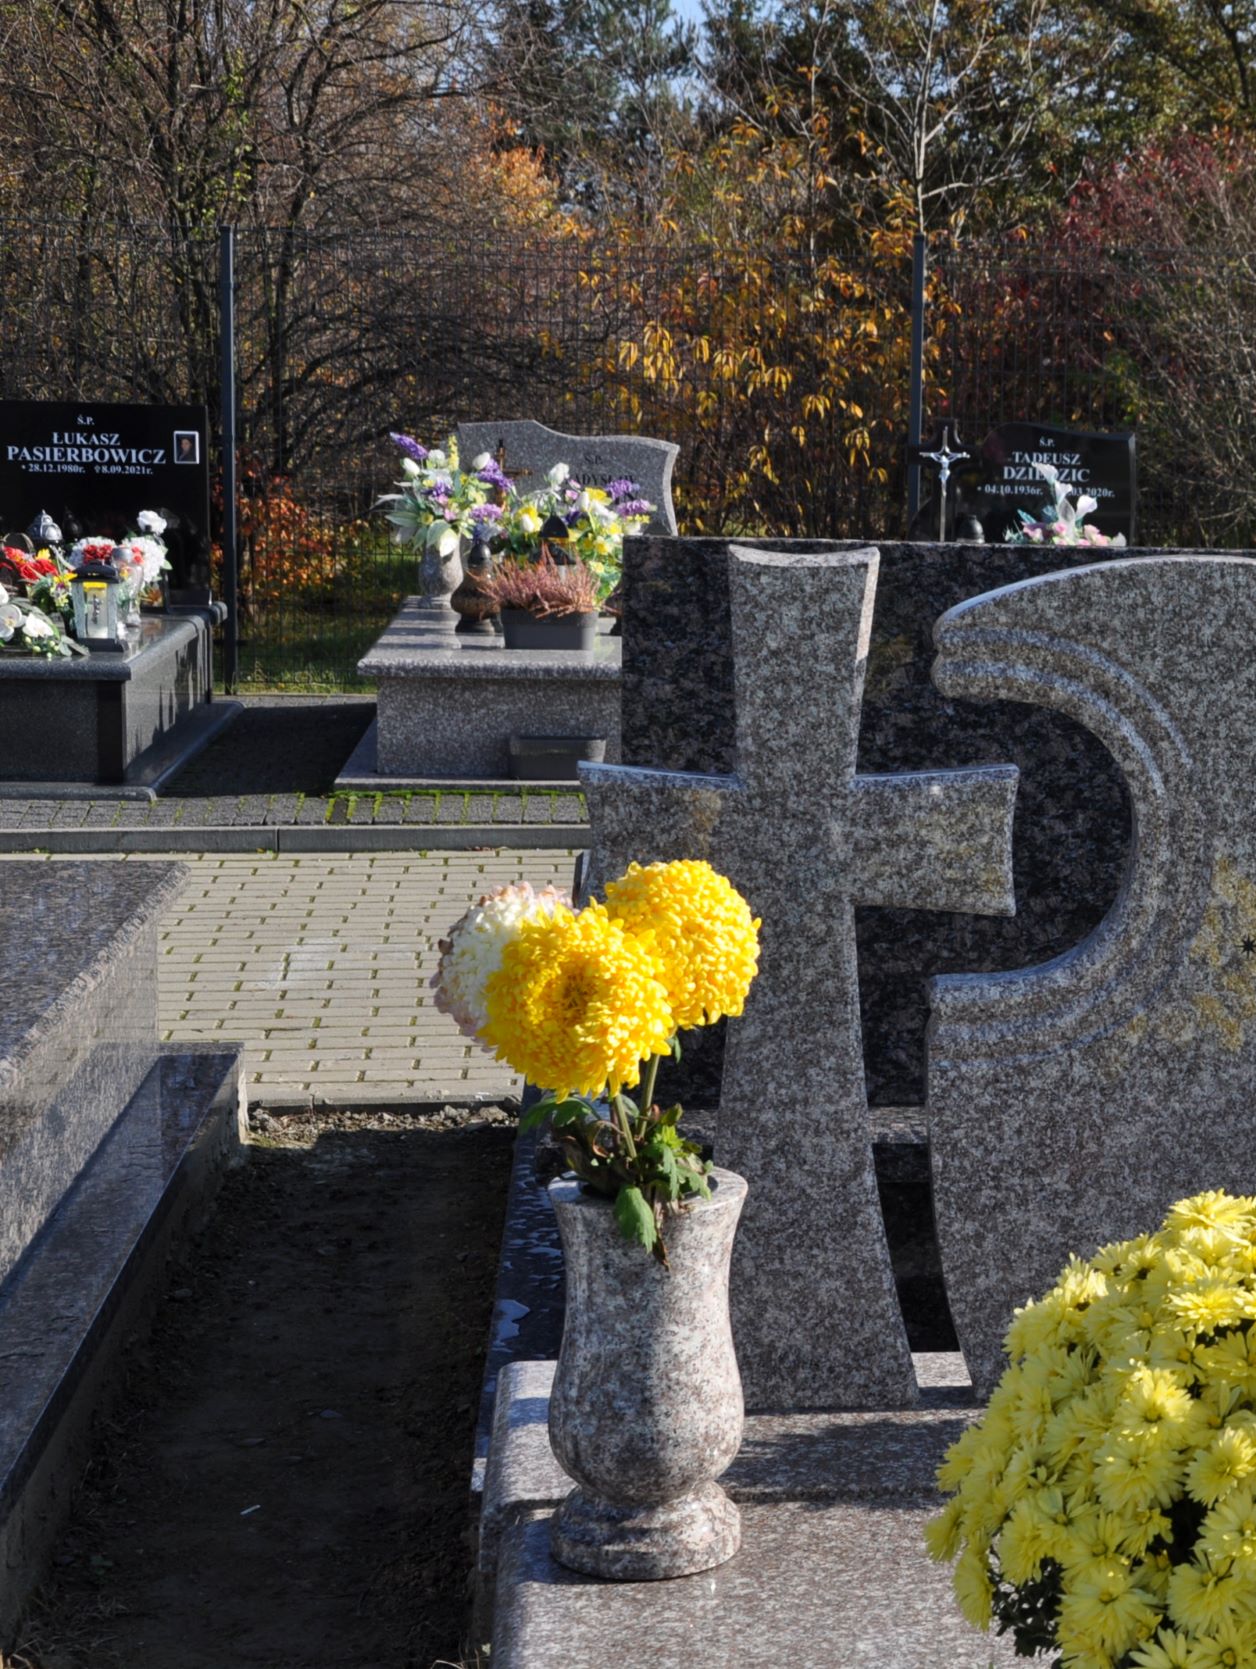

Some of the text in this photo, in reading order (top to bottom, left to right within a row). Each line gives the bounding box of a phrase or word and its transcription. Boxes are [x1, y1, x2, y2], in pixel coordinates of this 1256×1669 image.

[52, 431, 121, 446] ŁUKASZ
[6, 445, 167, 464] PASIERBOWICZ
[1012, 451, 1081, 465] TADEUSZ
